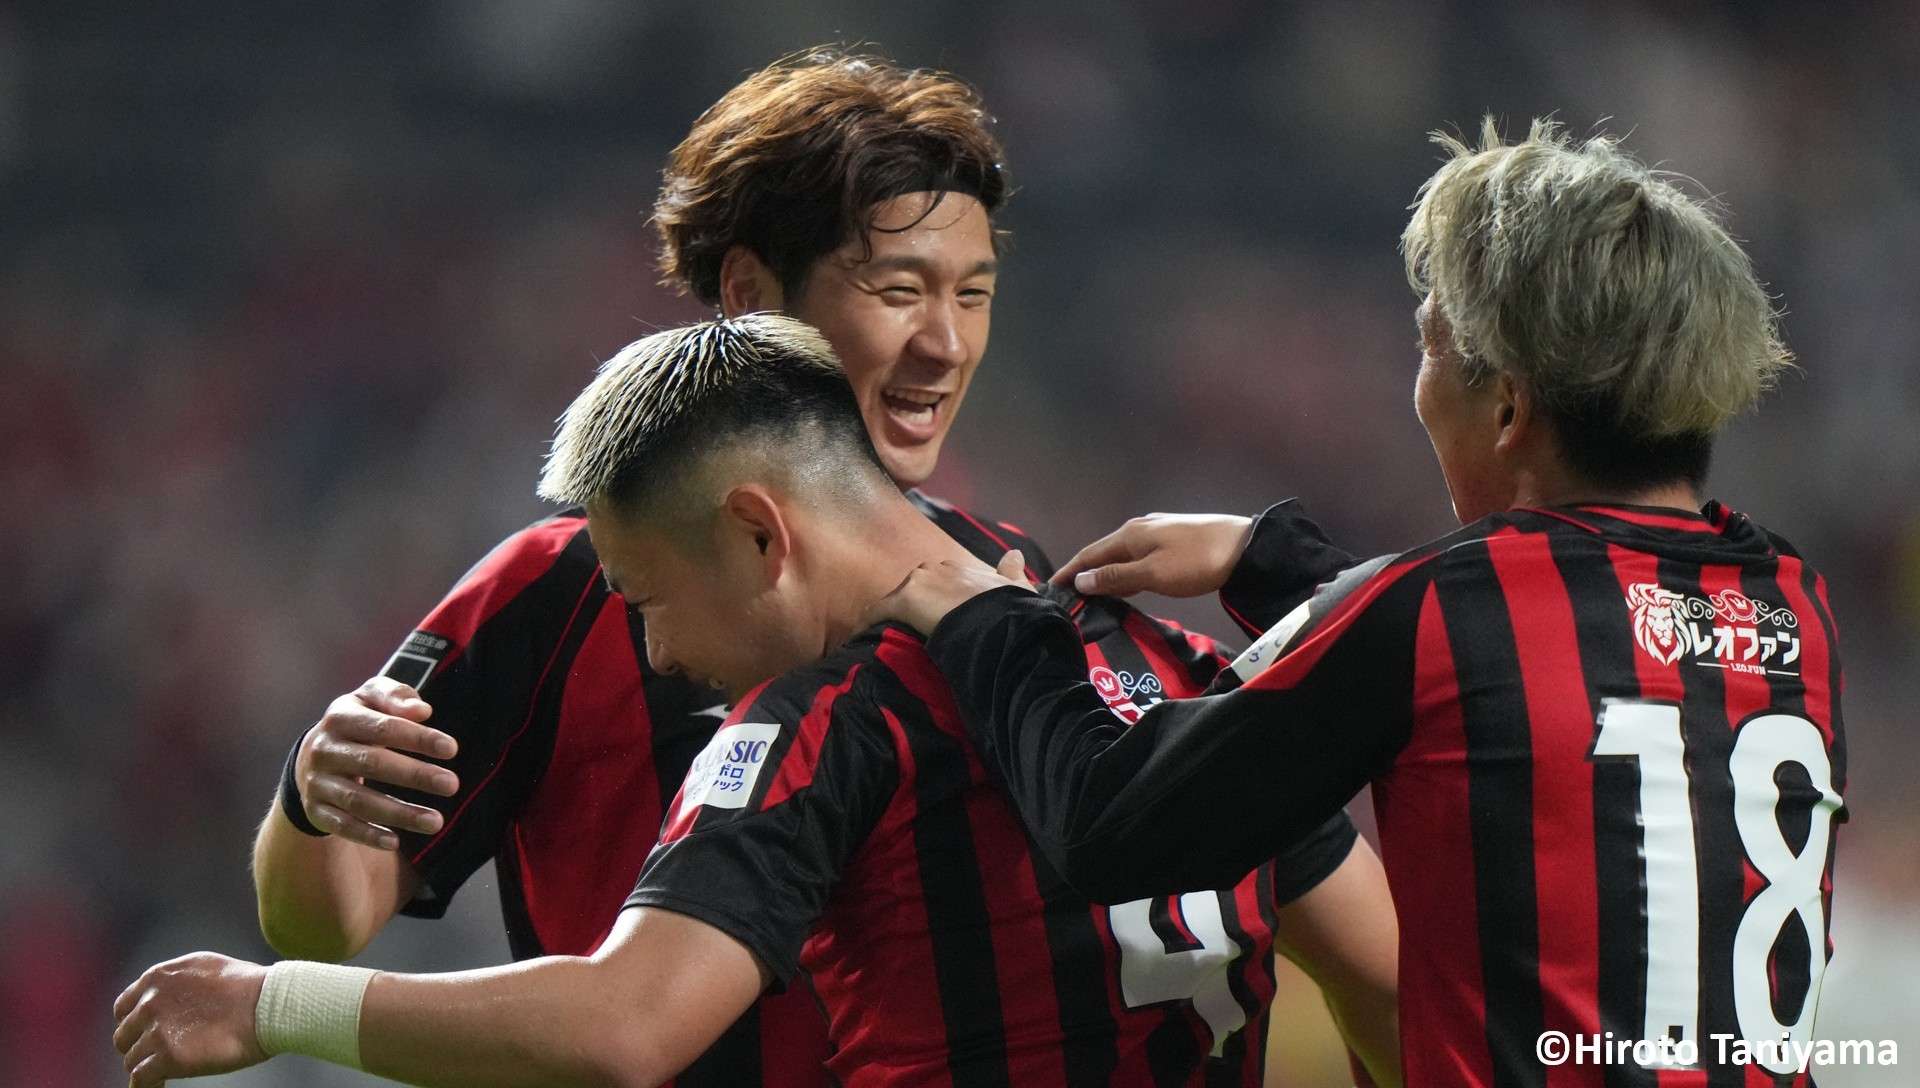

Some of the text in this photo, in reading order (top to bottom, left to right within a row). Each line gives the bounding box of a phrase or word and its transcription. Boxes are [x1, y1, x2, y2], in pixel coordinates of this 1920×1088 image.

[1689, 621, 1800, 665] レオファン
[1592, 699, 1843, 1075] 18
